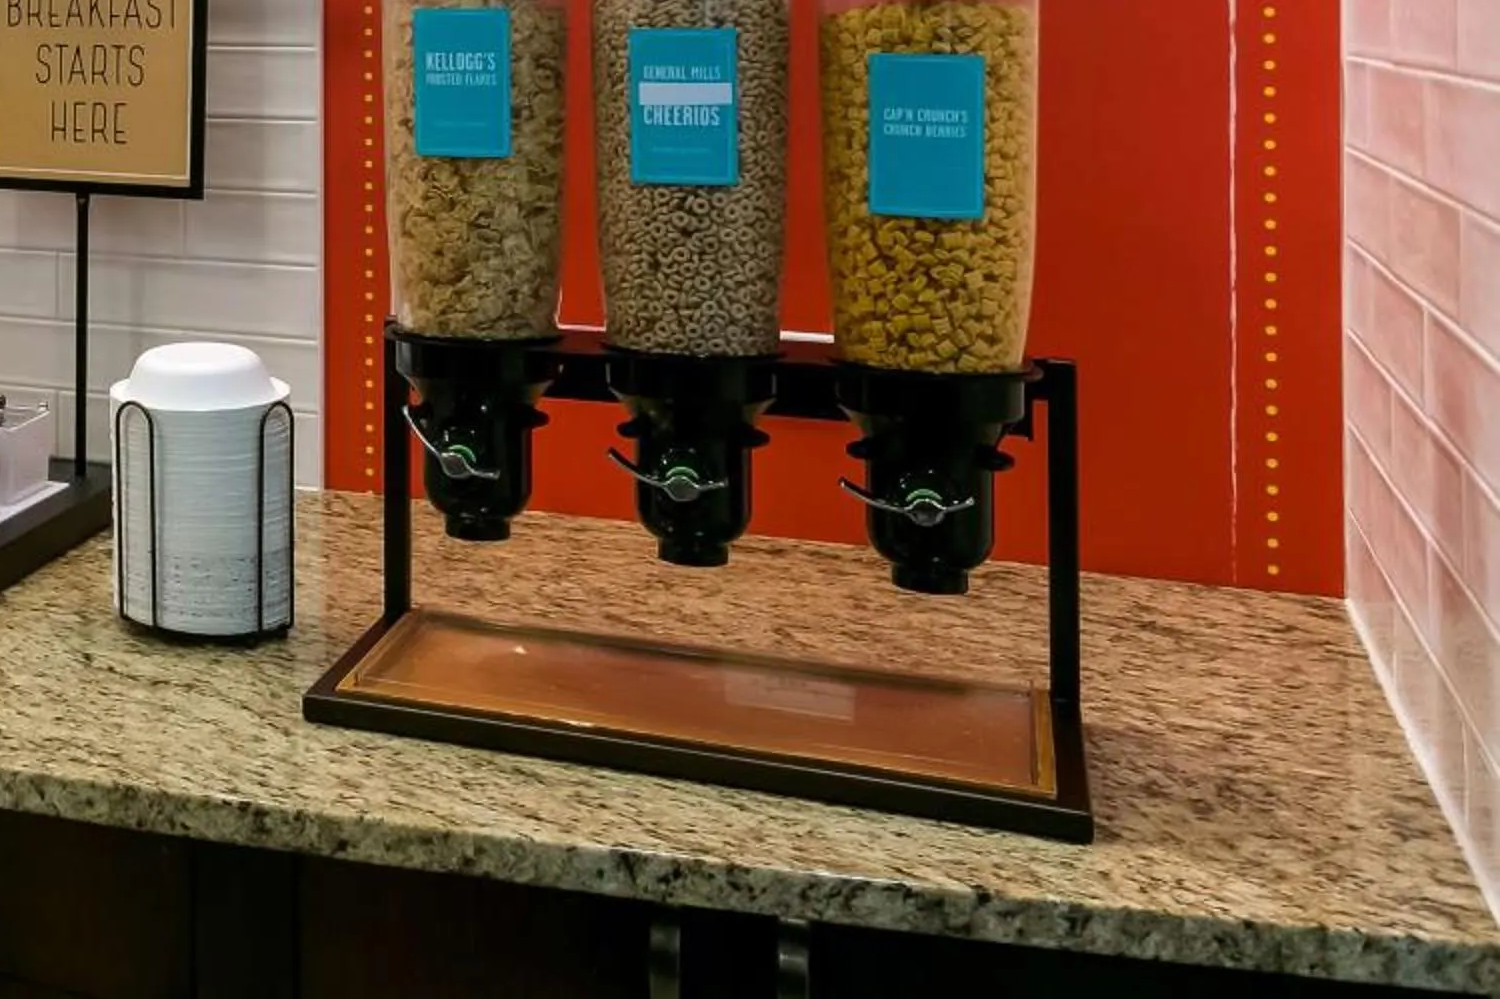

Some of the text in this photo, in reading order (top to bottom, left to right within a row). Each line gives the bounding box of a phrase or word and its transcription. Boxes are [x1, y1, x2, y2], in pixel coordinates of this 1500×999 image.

[35, 43, 146, 87] STARTS
[425, 51, 496, 72] KELLOGG'S
[643, 65, 721, 80] GENERAL MILLS
[50, 102, 127, 146] HERE
[643, 105, 721, 126] CHEERIOS
